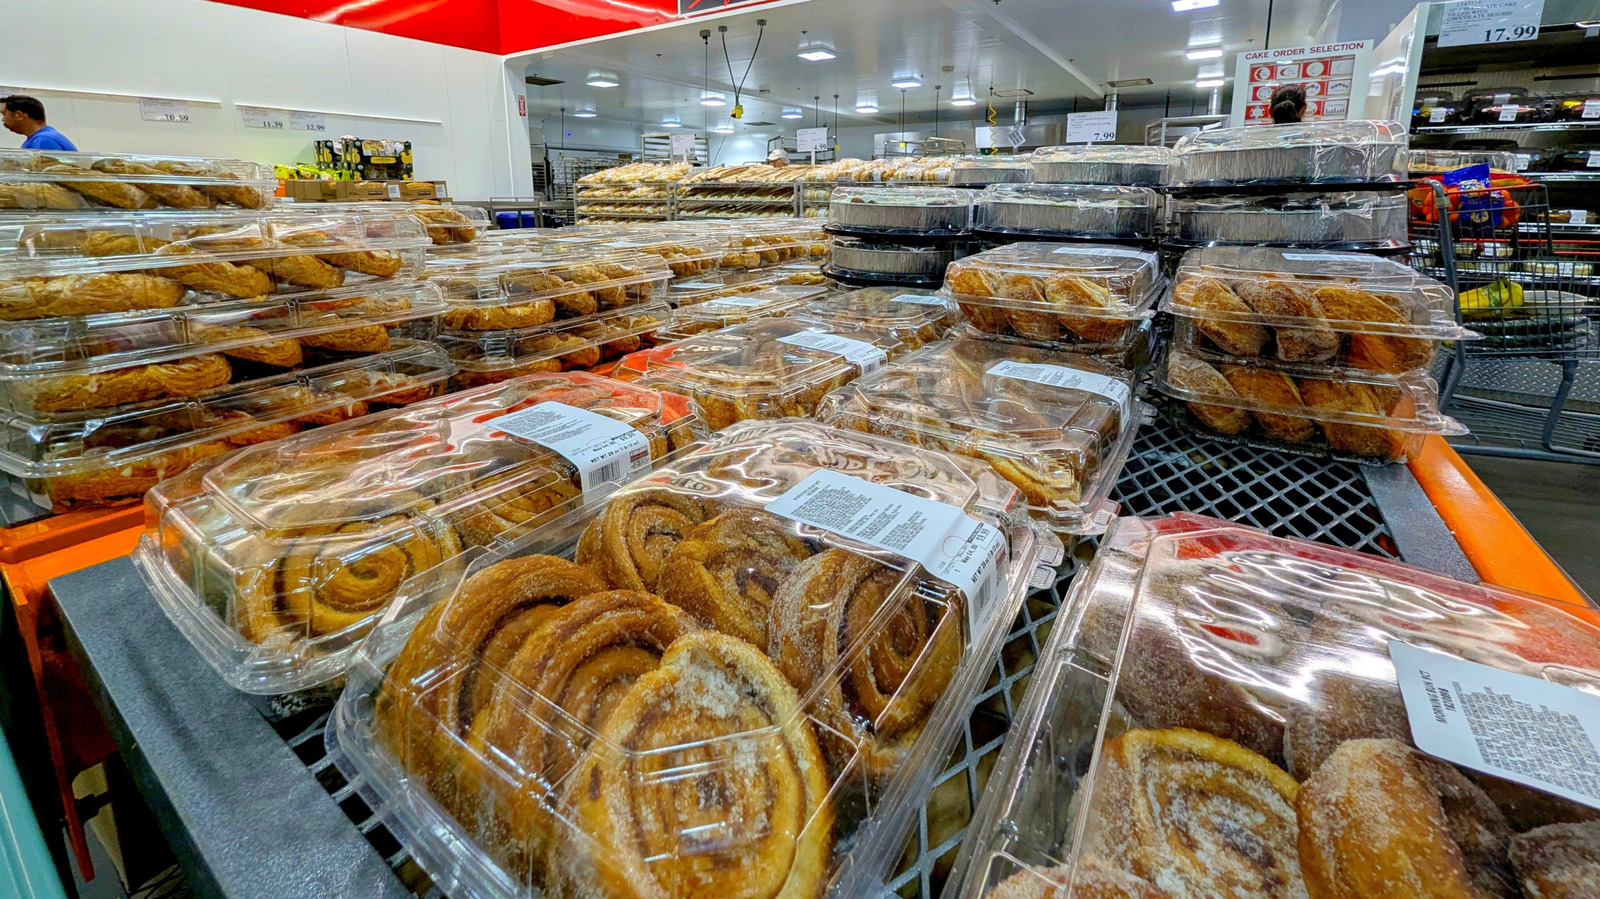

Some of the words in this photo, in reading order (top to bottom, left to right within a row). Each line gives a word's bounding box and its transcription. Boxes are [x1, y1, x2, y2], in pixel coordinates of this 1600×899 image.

[1447, 14, 1486, 22] CHOCOLATE
[1482, 25, 1537, 42] 17.99
[1245, 51, 1269, 60] CAKE
[1273, 48, 1305, 58] ORDER
[1309, 42, 1364, 54] SELECTION
[263, 120, 283, 128] 11.39
[1094, 132, 1115, 141] 7.99
[960, 555, 971, 564] May
[976, 528, 990, 542] $9.99
[971, 572, 979, 584] NET
[977, 565, 983, 575] WT
[1422, 680, 1437, 694] BUN
[1426, 692, 1448, 725] MORNING
